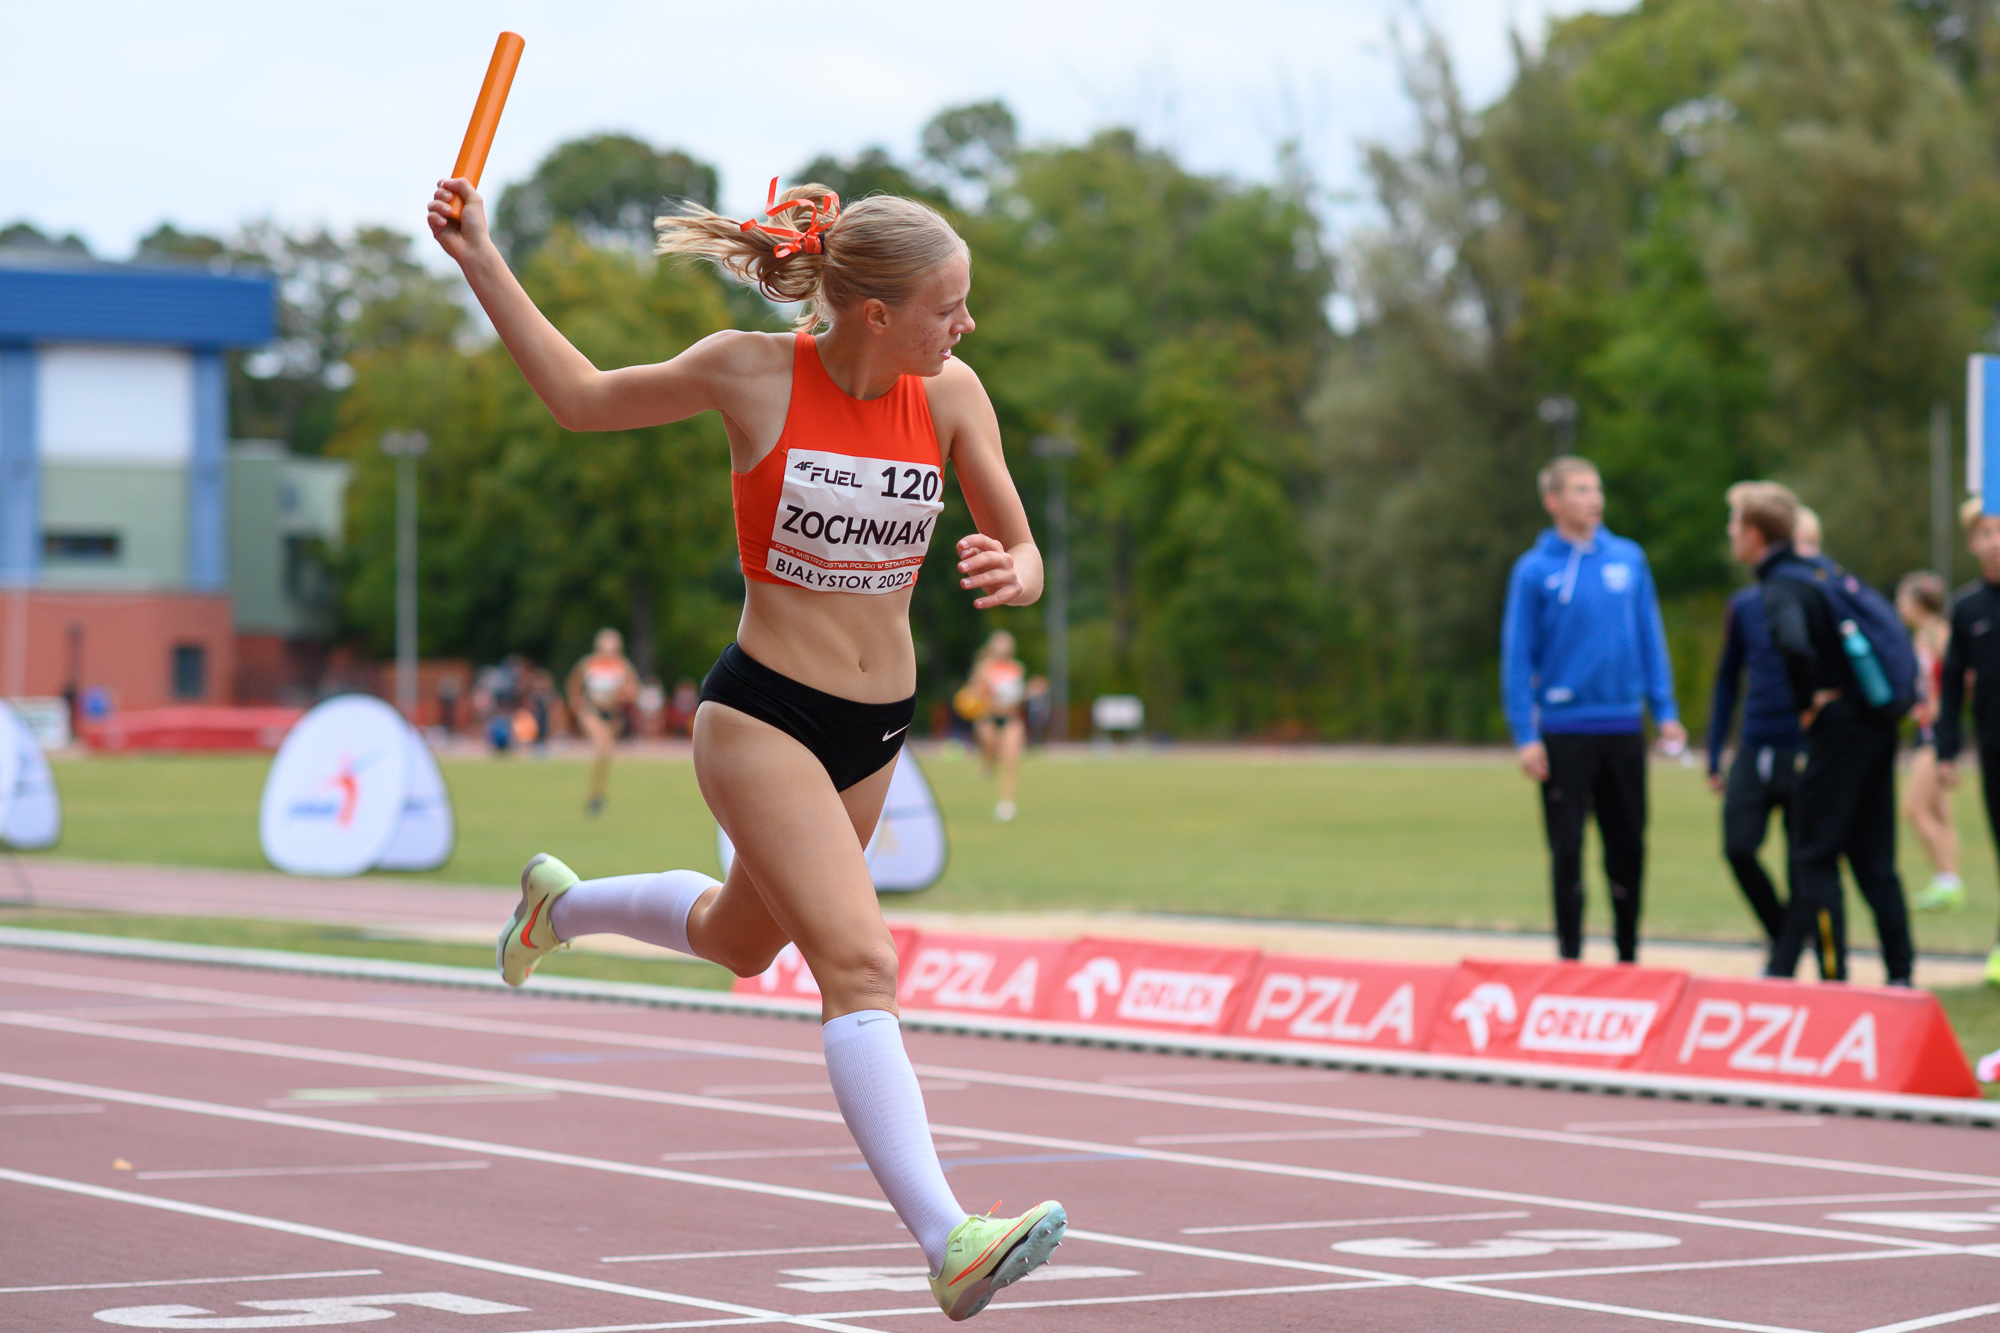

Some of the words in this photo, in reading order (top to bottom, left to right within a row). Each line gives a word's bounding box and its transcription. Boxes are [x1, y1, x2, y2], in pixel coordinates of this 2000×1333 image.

[810, 466, 863, 488] FUEL
[880, 466, 938, 501] 120
[781, 504, 933, 546] ZOCHNIAK
[775, 543, 795, 555] PZLA
[795, 551, 849, 568] MISTRZOSTWA
[775, 557, 873, 589] BIAŁYSTOK
[876, 571, 913, 589] 2022
[903, 946, 1040, 1013] PZLA
[1246, 972, 1414, 1045] PZLA
[1534, 1007, 1643, 1043] ORLEN
[1678, 999, 1878, 1081] PZLA
